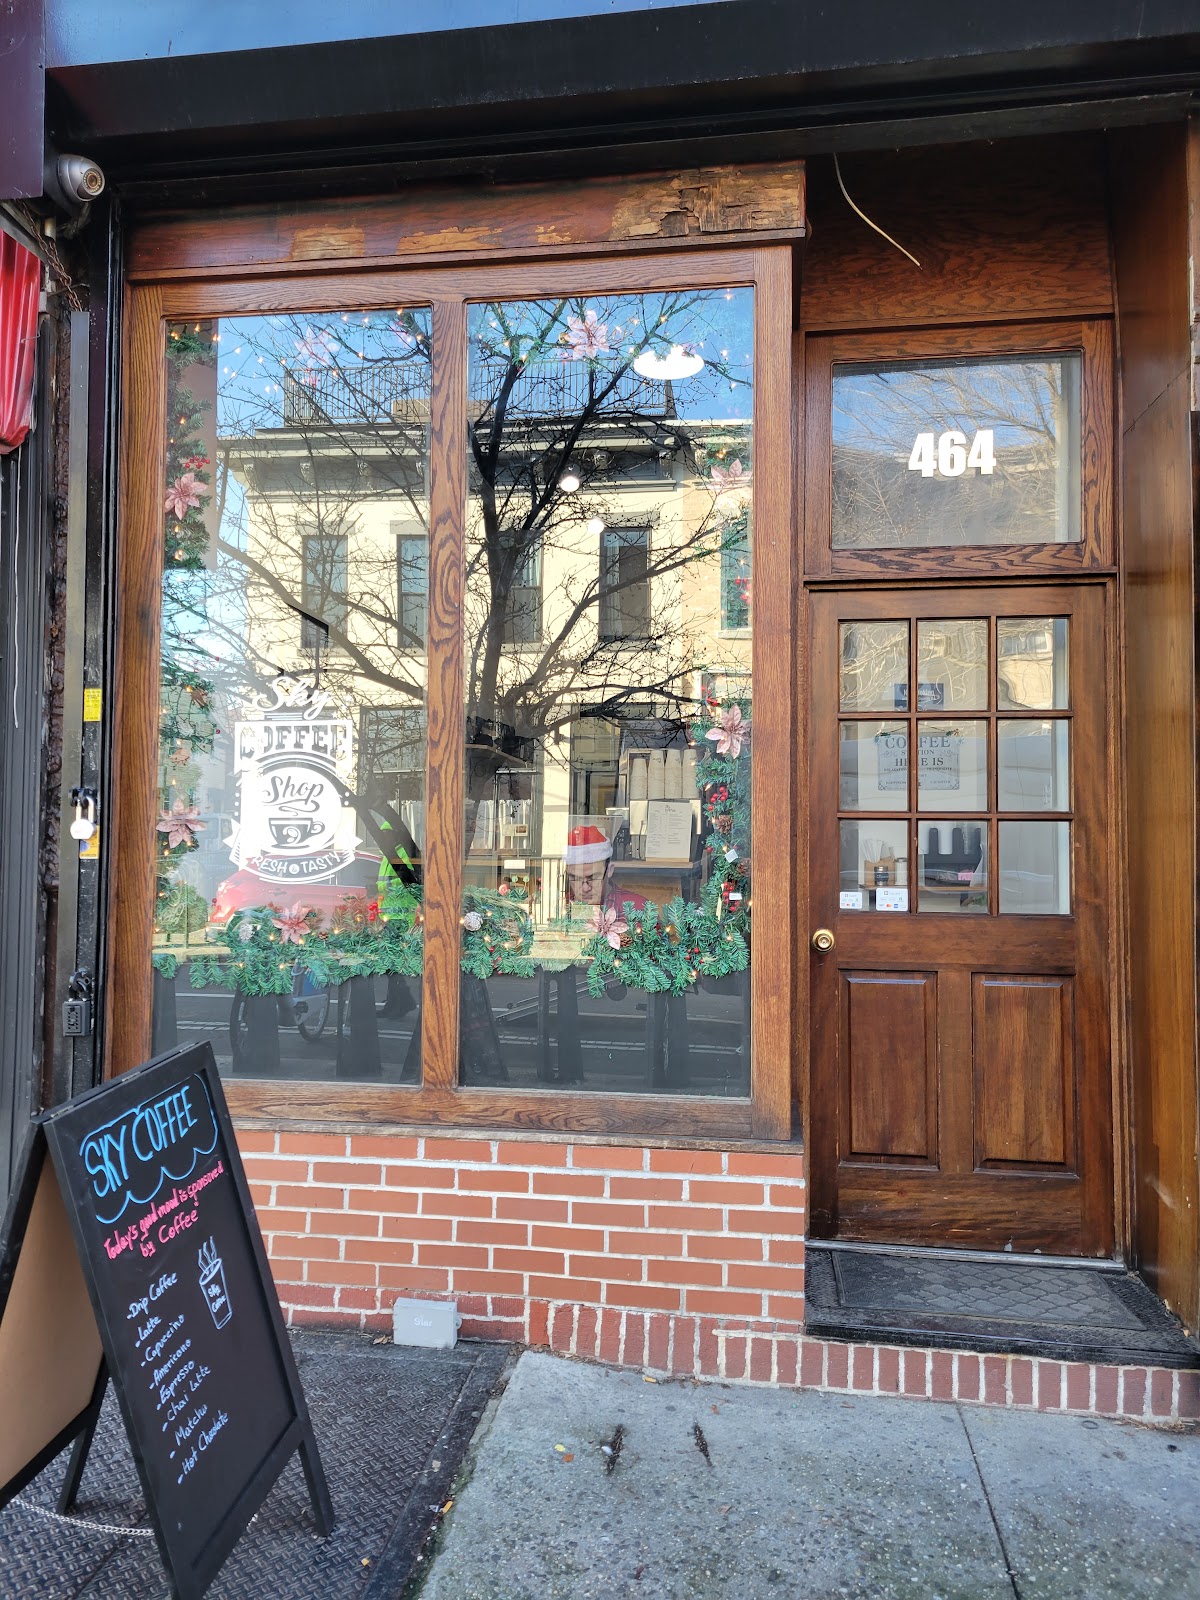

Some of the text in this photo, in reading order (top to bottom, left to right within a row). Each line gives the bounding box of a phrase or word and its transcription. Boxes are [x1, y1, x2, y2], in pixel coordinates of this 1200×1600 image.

[908, 429, 997, 478] 464
[255, 675, 334, 720] Sky
[885, 736, 951, 749] COFEE
[932, 757, 944, 766] IS
[262, 775, 325, 806] Shop
[249, 854, 288, 874] RESH
[300, 850, 341, 874] TASTY
[84, 1085, 198, 1198] SKY COFFEE
[103, 1160, 224, 1260] Today's good mood is sponsored
[139, 1208, 199, 1258] by Coffee
[149, 1272, 178, 1301] Coffee
[137, 1315, 162, 1341] Latte
[153, 1338, 191, 1387] Americano
[160, 1360, 195, 1405] Espresso
[181, 1446, 198, 1475] Hot
